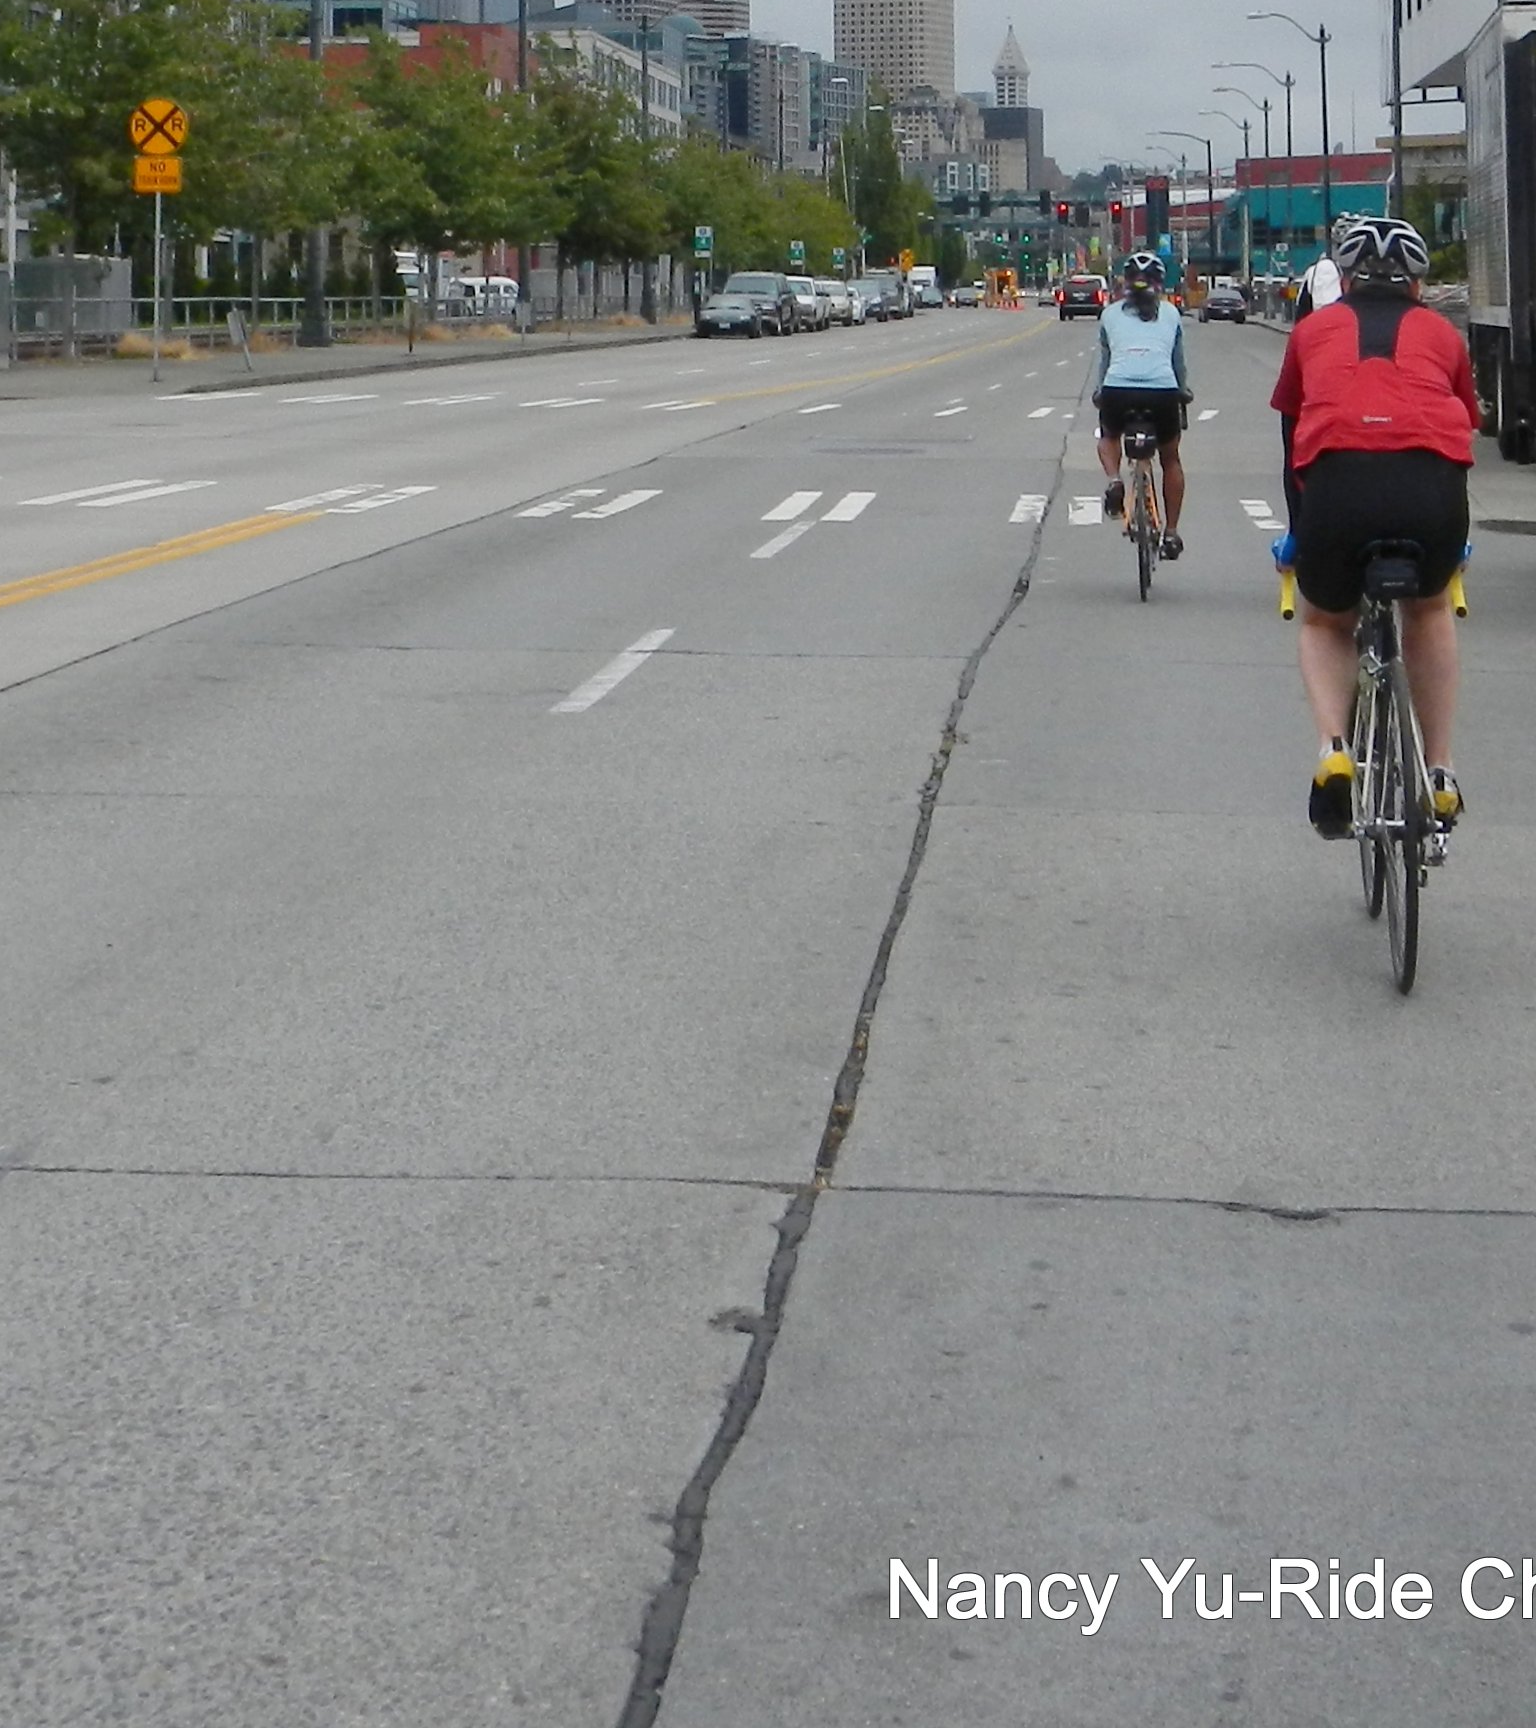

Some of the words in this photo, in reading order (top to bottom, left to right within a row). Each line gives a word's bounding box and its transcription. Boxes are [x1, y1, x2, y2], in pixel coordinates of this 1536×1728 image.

[134, 118, 146, 132] R
[171, 117, 183, 131] R
[149, 161, 166, 173] NO
